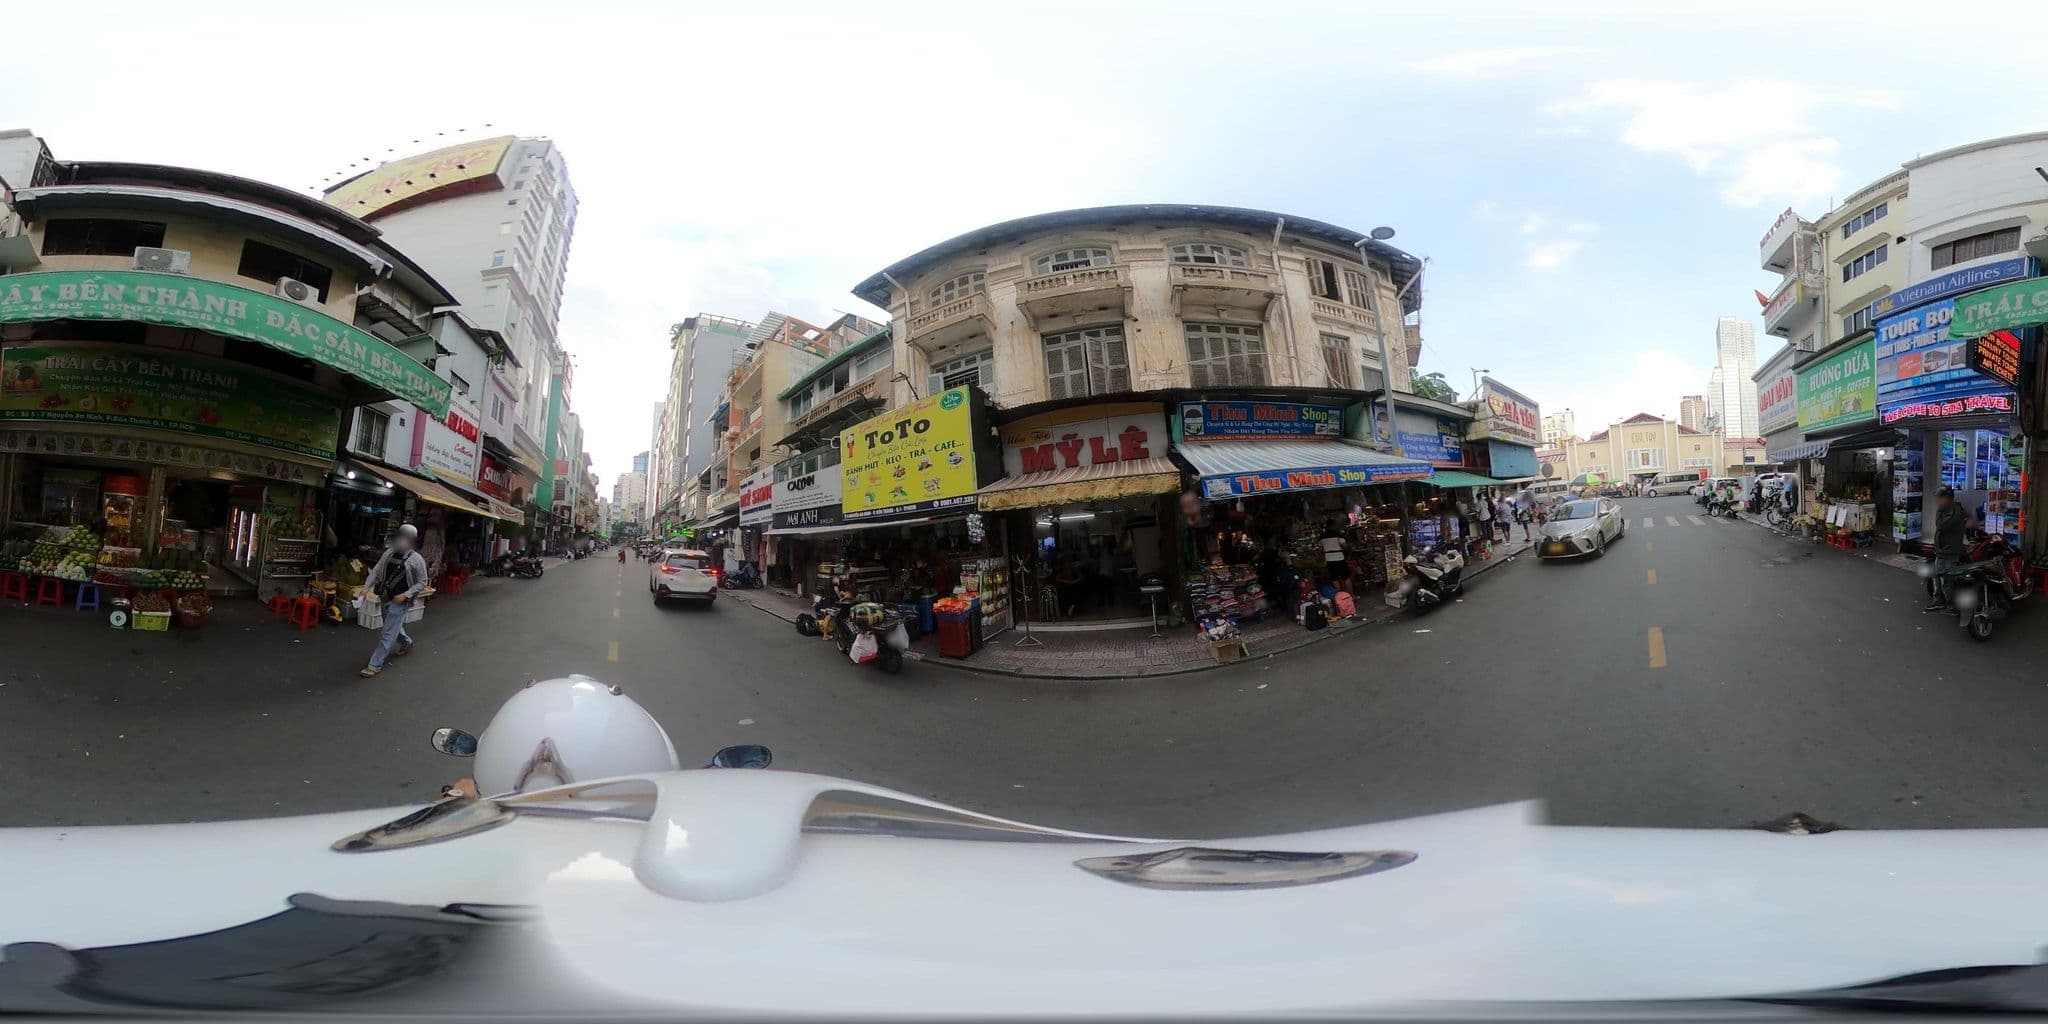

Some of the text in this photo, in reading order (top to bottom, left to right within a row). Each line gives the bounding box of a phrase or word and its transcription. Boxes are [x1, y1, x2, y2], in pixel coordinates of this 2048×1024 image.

[57, 276, 126, 302] BẾN
[135, 286, 248, 320] THÀNH
[1899, 267, 2001, 303] Vietnam Airlines
[1965, 293, 2023, 322] TRÁI
[1880, 318, 1920, 342] TOUR
[1925, 308, 1954, 329] BO
[266, 309, 320, 341] ĐẶC
[326, 329, 367, 360] SẢN
[371, 351, 402, 378] BẾN
[1978, 336, 2001, 355] LUXURY
[1978, 345, 2001, 365] PRIVATE
[46, 353, 83, 370] TRÁI
[93, 357, 133, 376] CÂY
[1983, 358, 1993, 369] AIR
[1846, 376, 1872, 393] COFFEE
[1209, 404, 1328, 422] Thu Minh Shop
[1884, 402, 1927, 423] WELCOME
[1928, 404, 1941, 417] TO
[1964, 394, 2011, 411] TRAVEL
[864, 419, 931, 449] ToTo
[1020, 424, 1149, 474] MỸ LÊ
[1237, 475, 1281, 493] Thu
[1287, 471, 1336, 489] Minh
[1338, 469, 1367, 484] Shop
[800, 508, 818, 525] ANH
